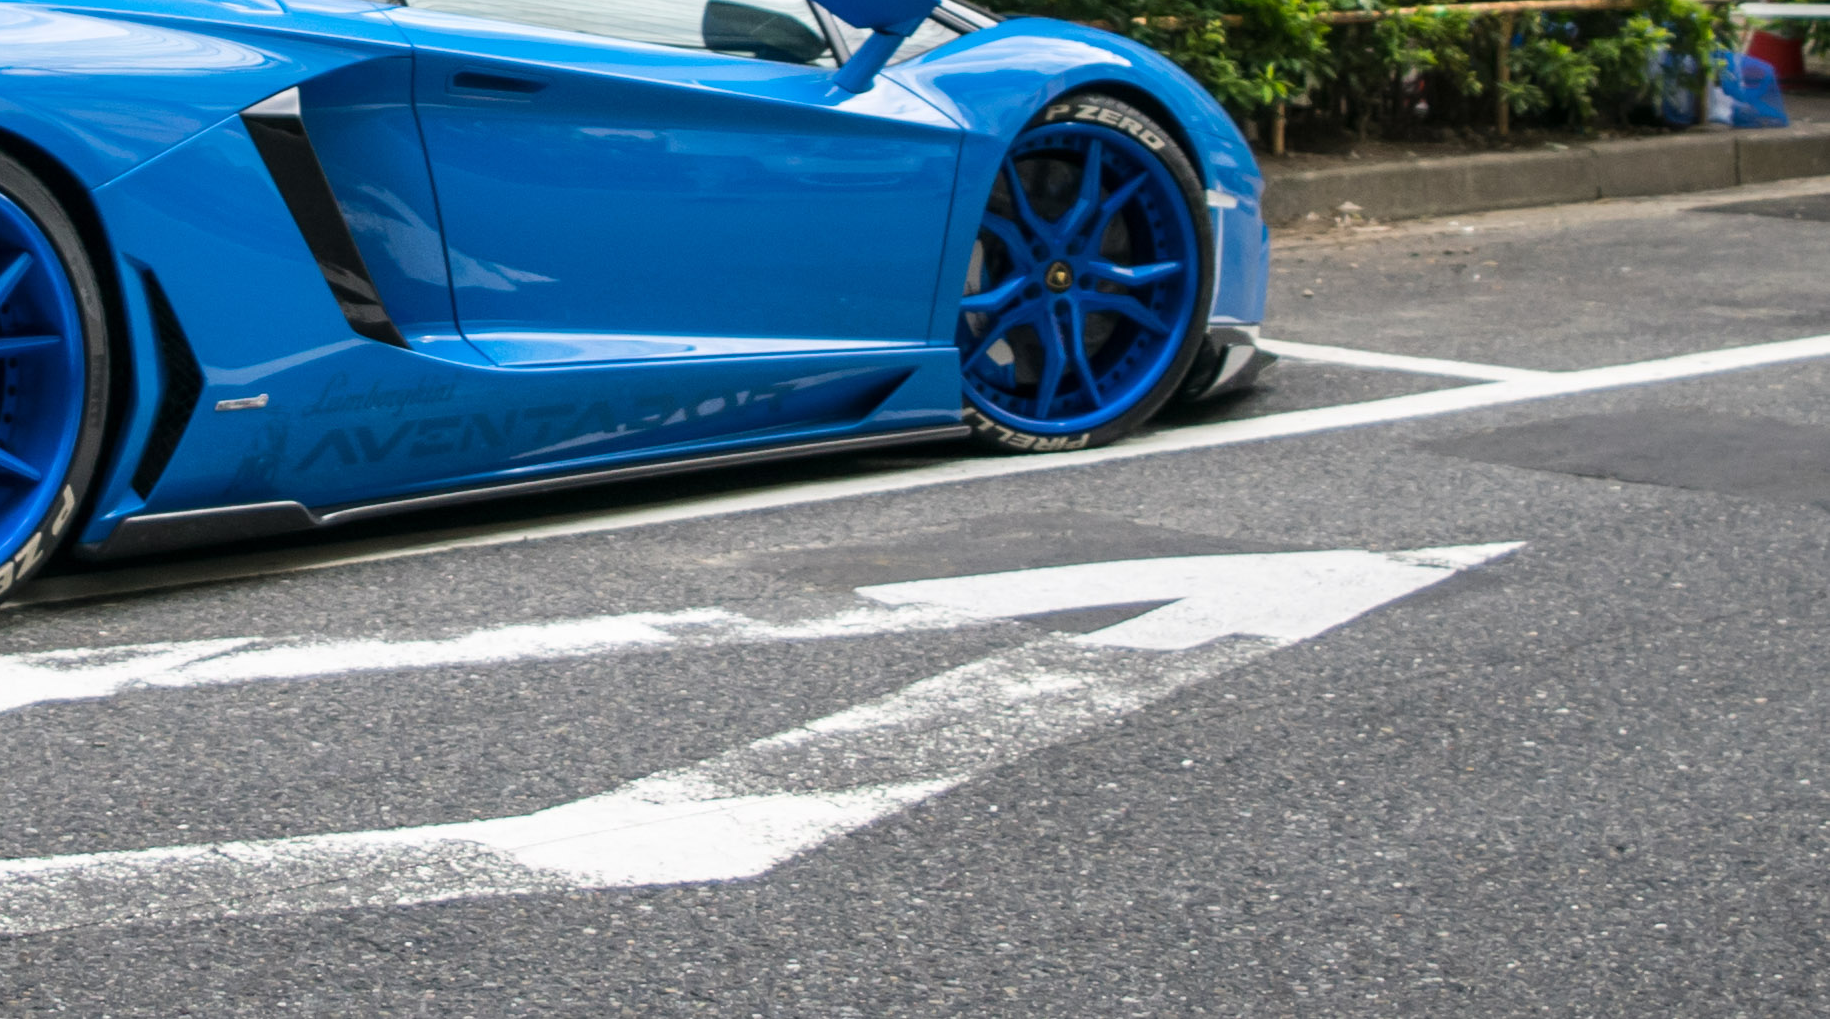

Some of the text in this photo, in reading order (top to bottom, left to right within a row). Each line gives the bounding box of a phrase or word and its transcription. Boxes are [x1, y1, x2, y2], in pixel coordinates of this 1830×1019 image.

[1045, 104, 1165, 152] P ZERO
[303, 371, 462, 416] Lamborghini
